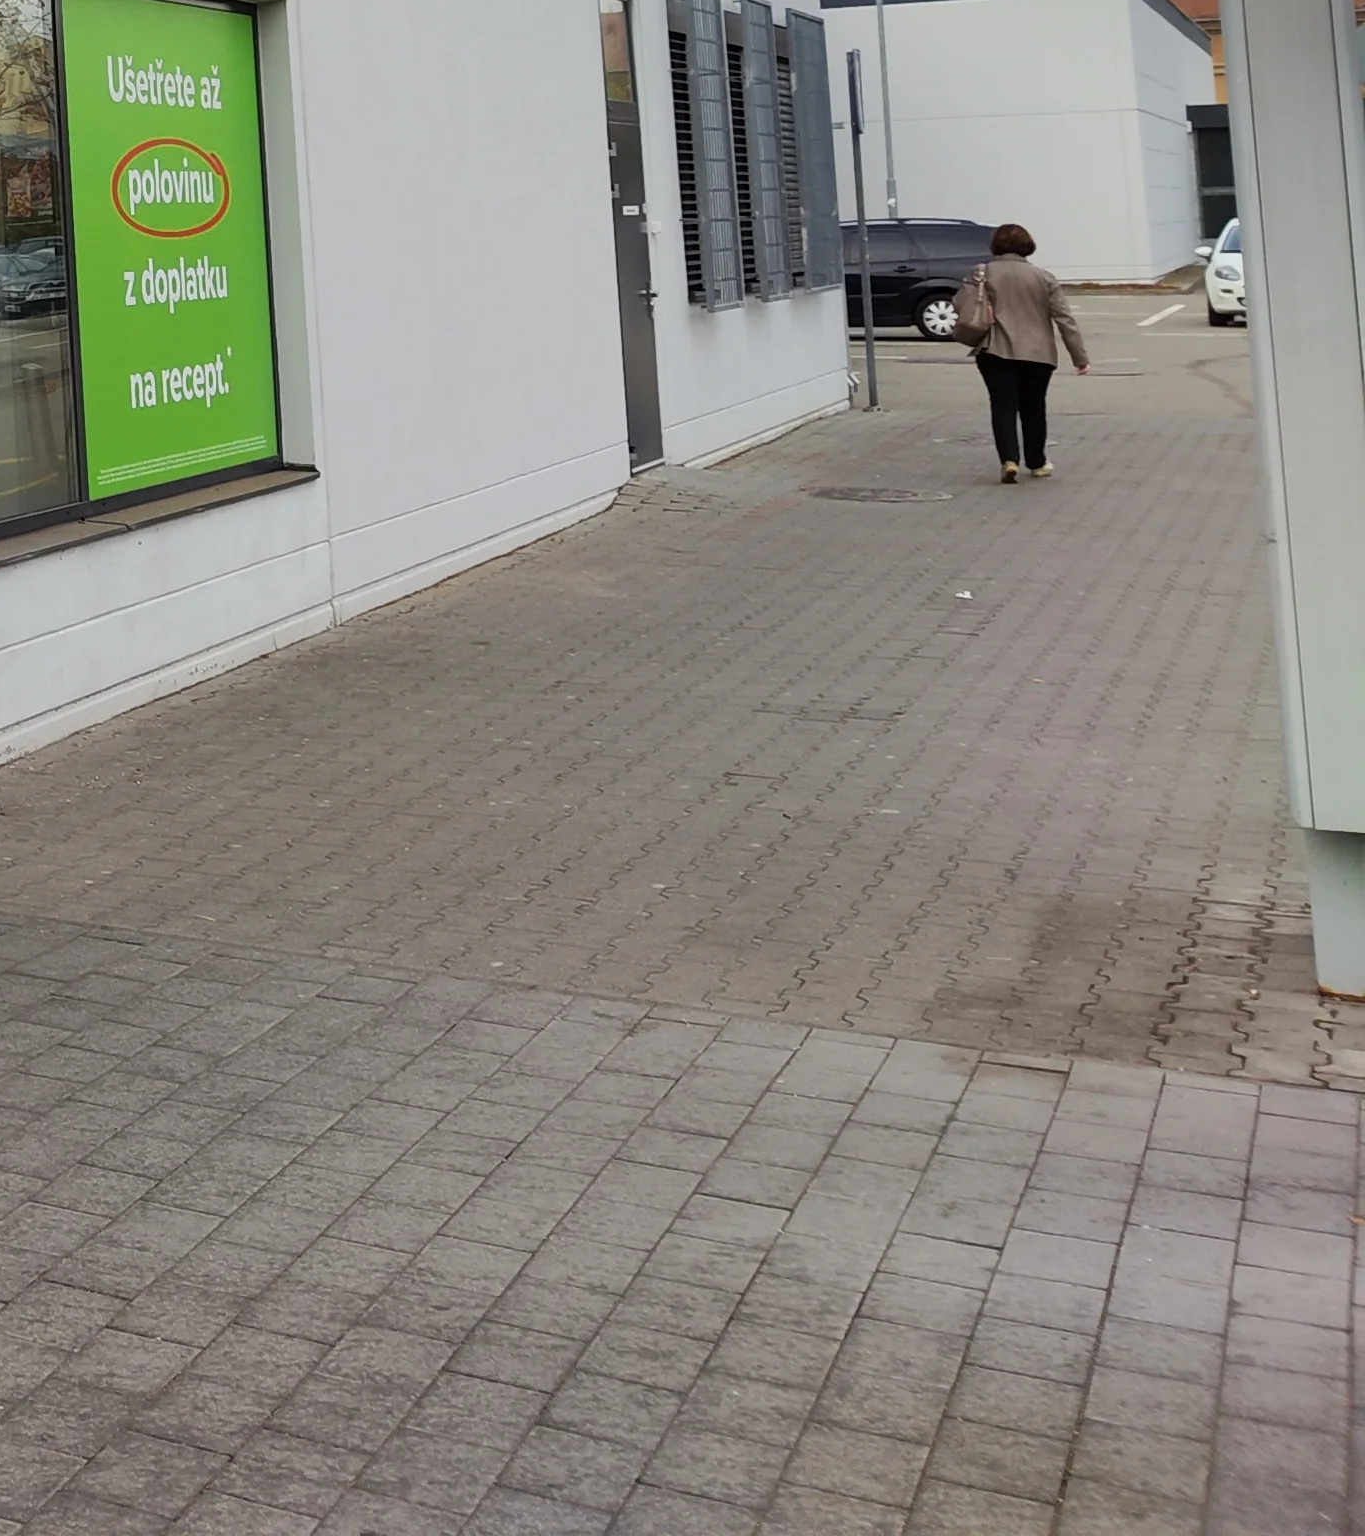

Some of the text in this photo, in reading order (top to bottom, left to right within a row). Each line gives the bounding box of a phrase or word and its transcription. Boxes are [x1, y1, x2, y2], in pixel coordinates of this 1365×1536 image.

[106, 54, 222, 110] Ušetřete až
[127, 156, 215, 216] polovinu
[123, 255, 228, 315] z doplatku
[129, 370, 157, 409] na
